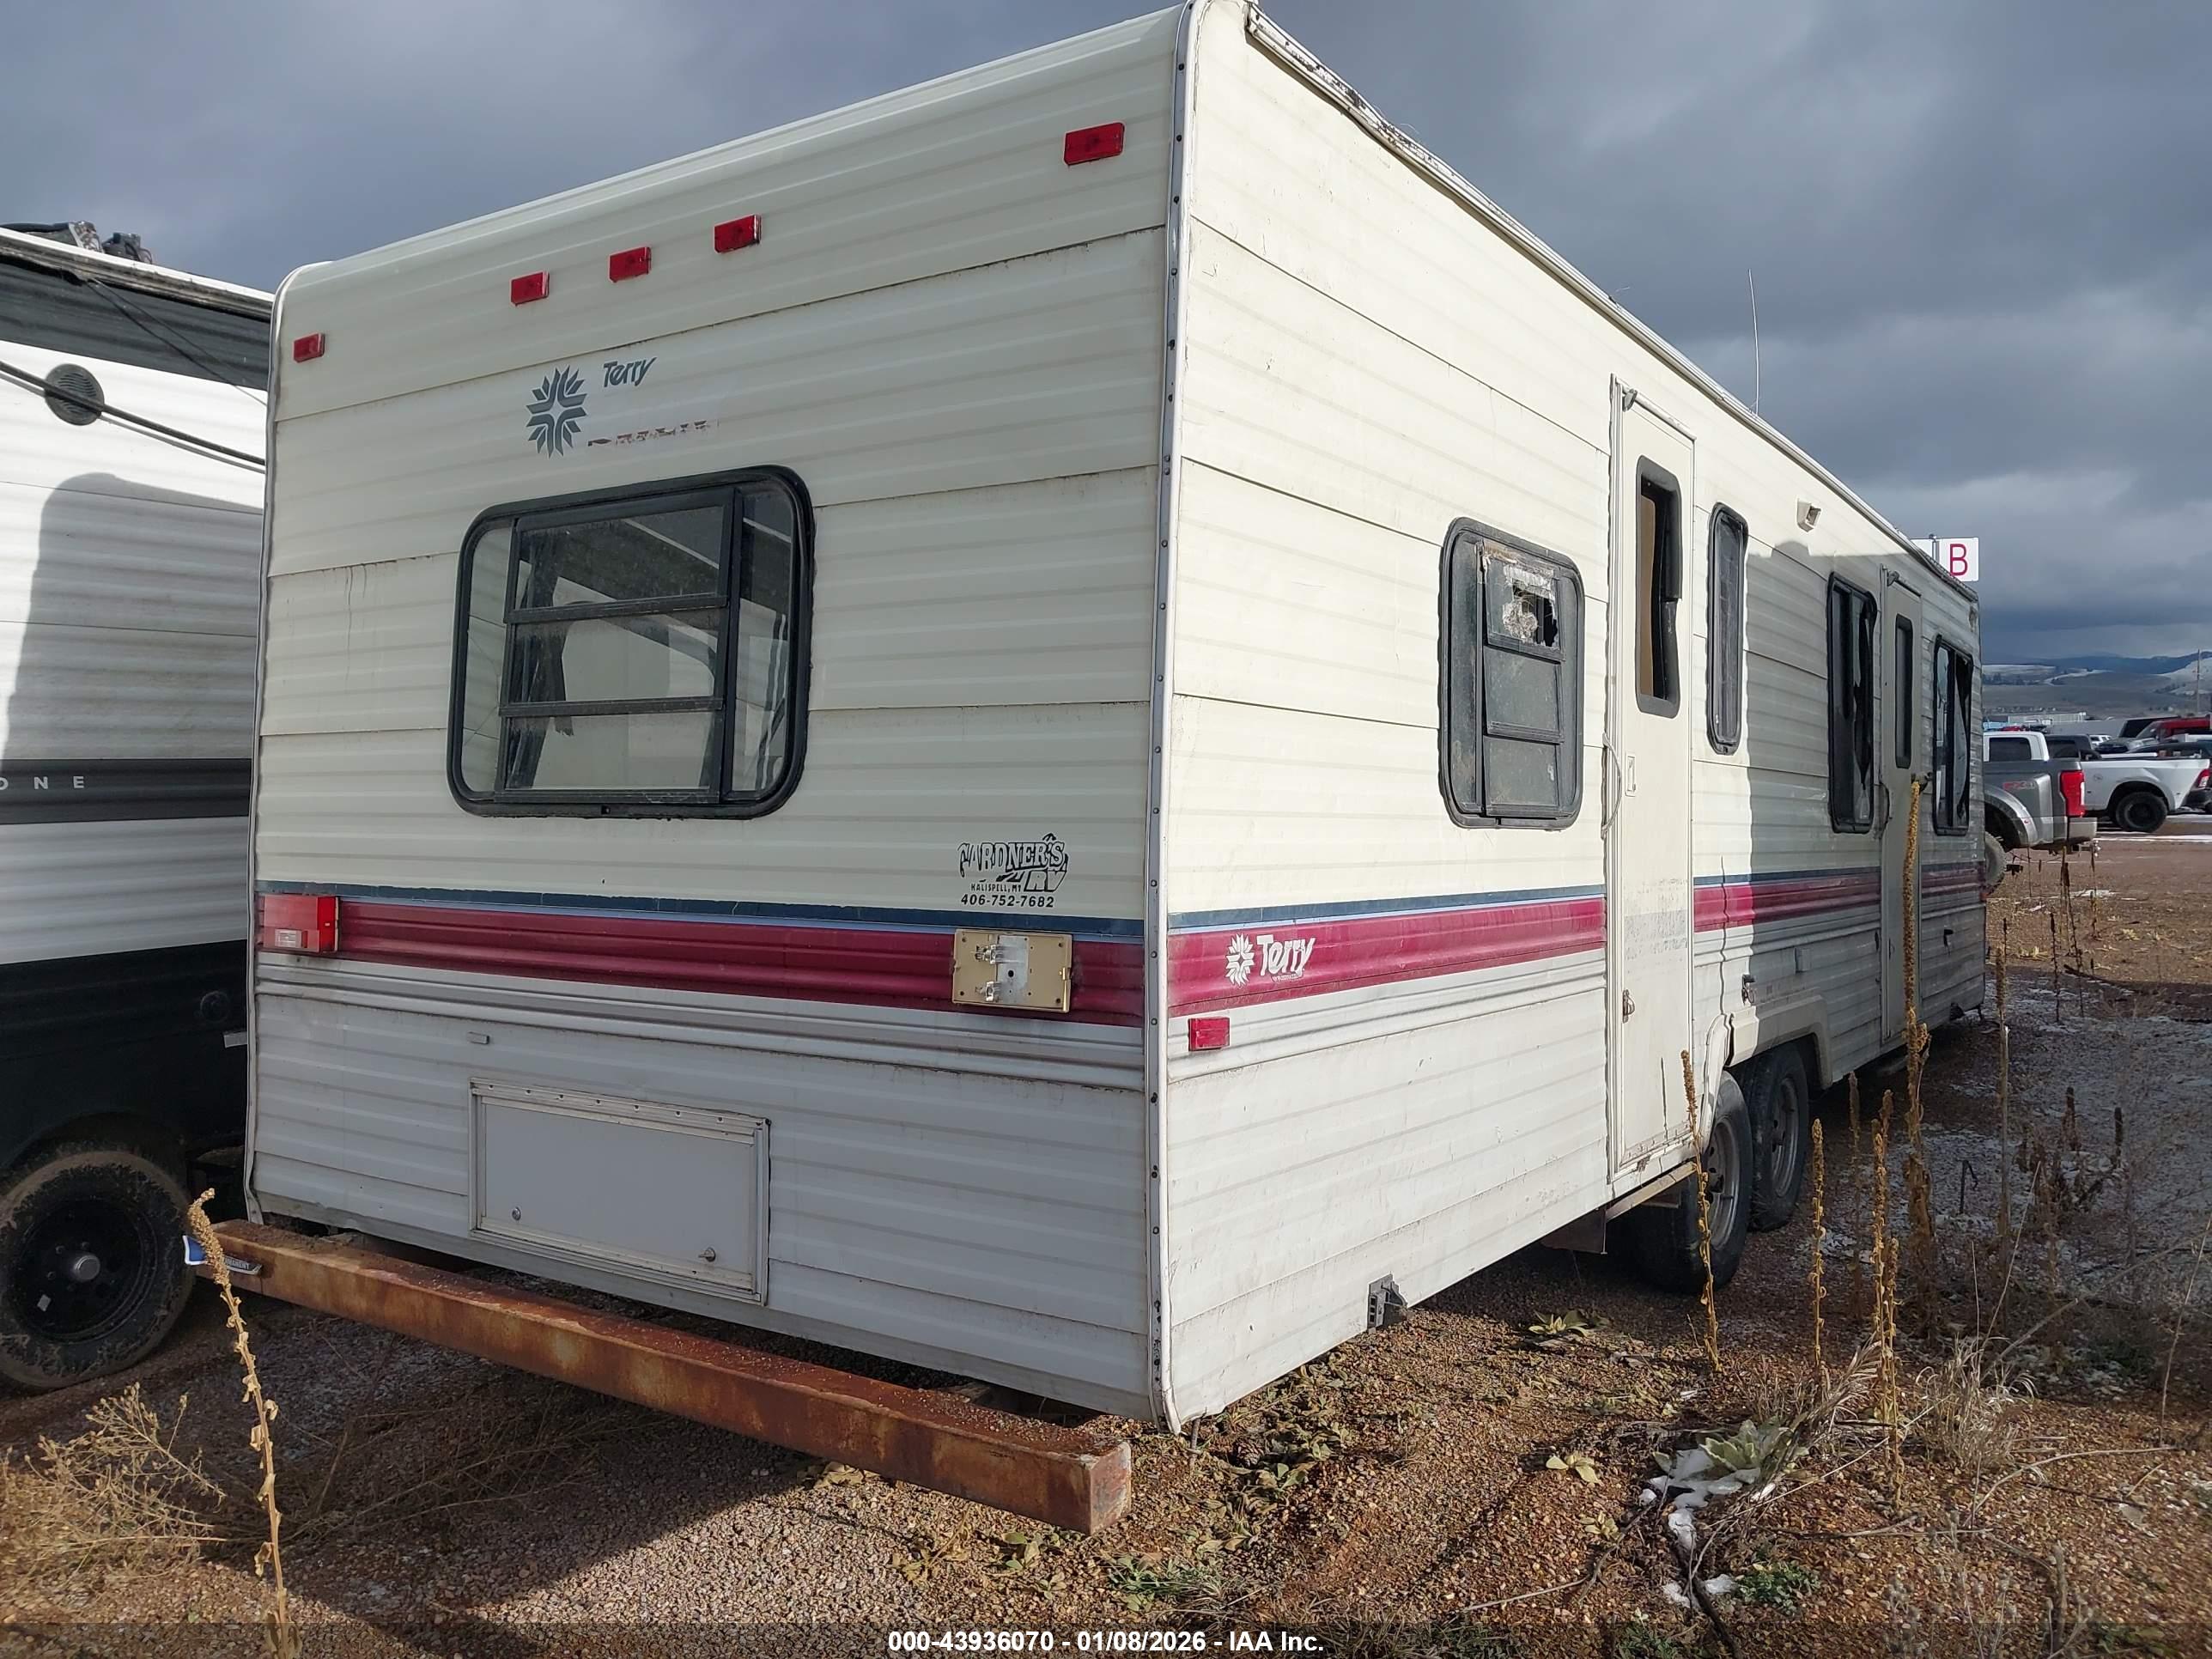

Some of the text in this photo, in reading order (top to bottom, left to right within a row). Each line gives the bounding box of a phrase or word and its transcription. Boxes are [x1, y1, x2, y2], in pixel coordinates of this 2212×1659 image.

[603, 357, 657, 387] Terry
[1949, 544, 1968, 576] B
[957, 841, 1066, 878] GARDNER'S
[1023, 869, 1066, 892] RV
[961, 893, 1054, 908] 406-752-7682
[1256, 933, 1316, 977] Terry
